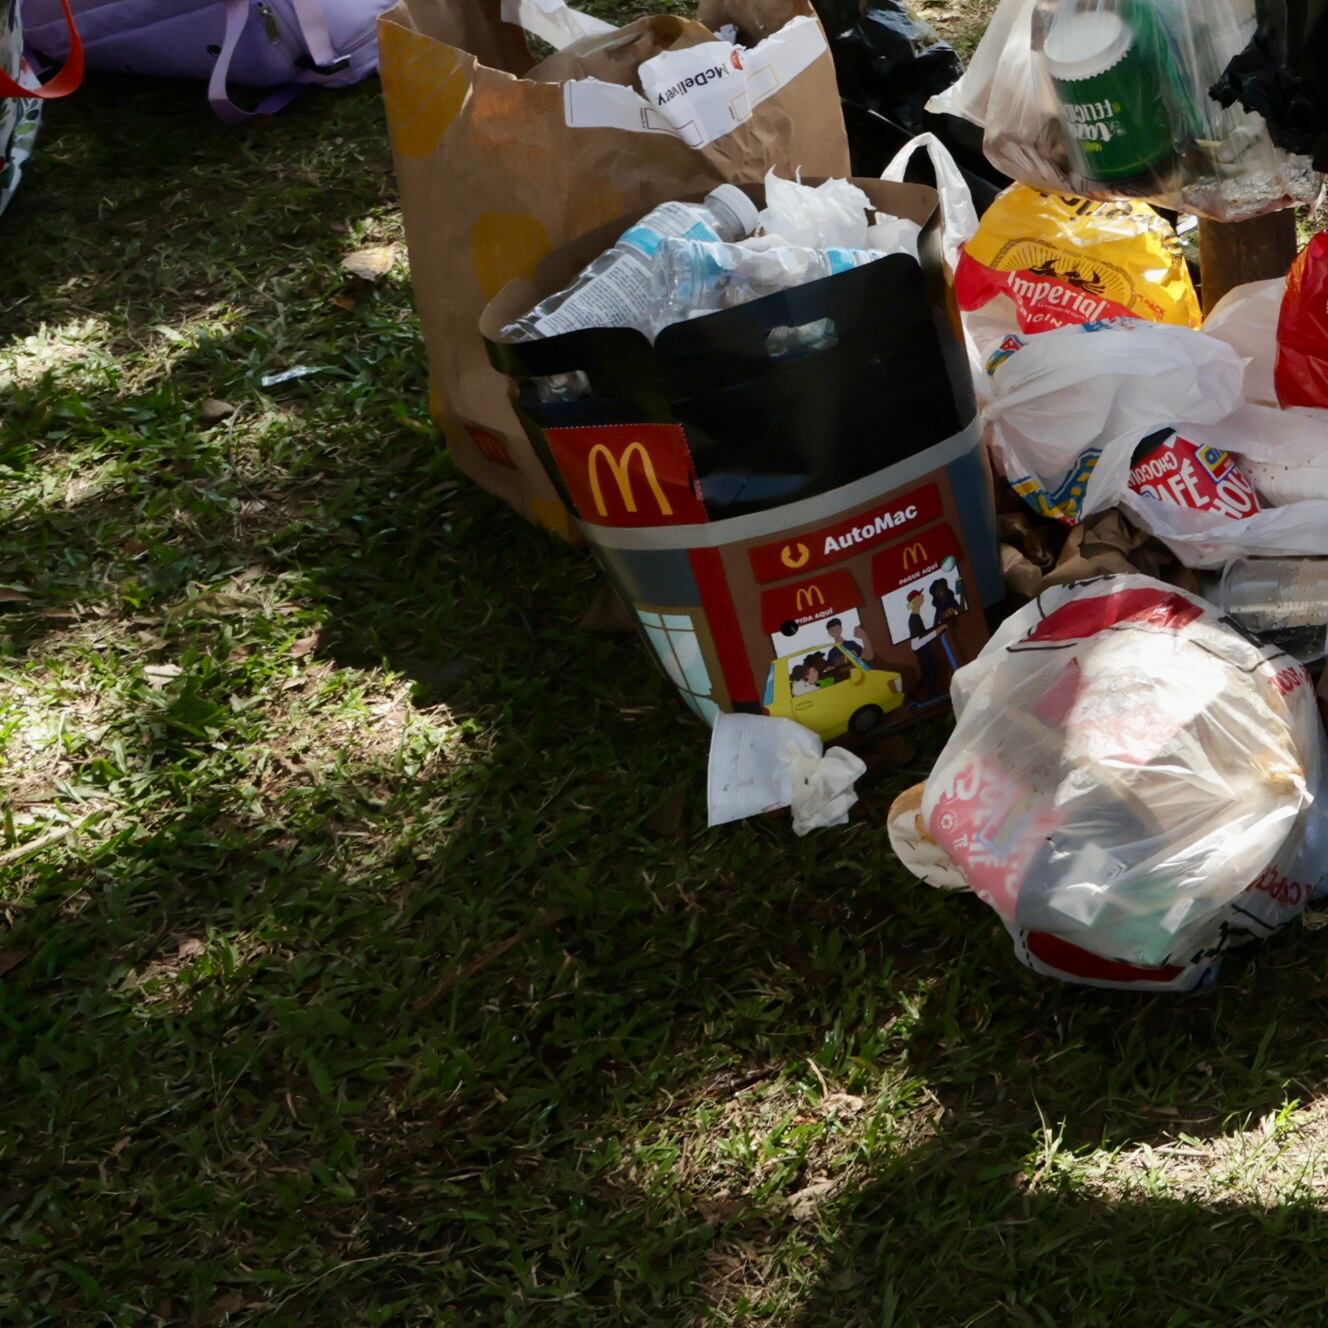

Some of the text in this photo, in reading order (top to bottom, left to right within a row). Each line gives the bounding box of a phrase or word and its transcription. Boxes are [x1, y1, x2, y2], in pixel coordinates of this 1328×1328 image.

[657, 63, 730, 106] McDelivery
[1006, 270, 1108, 323] Imperial
[823, 505, 918, 555] AutoMac
[921, 562, 939, 576] AQUÍ
[814, 607, 834, 619] AQUÍ
